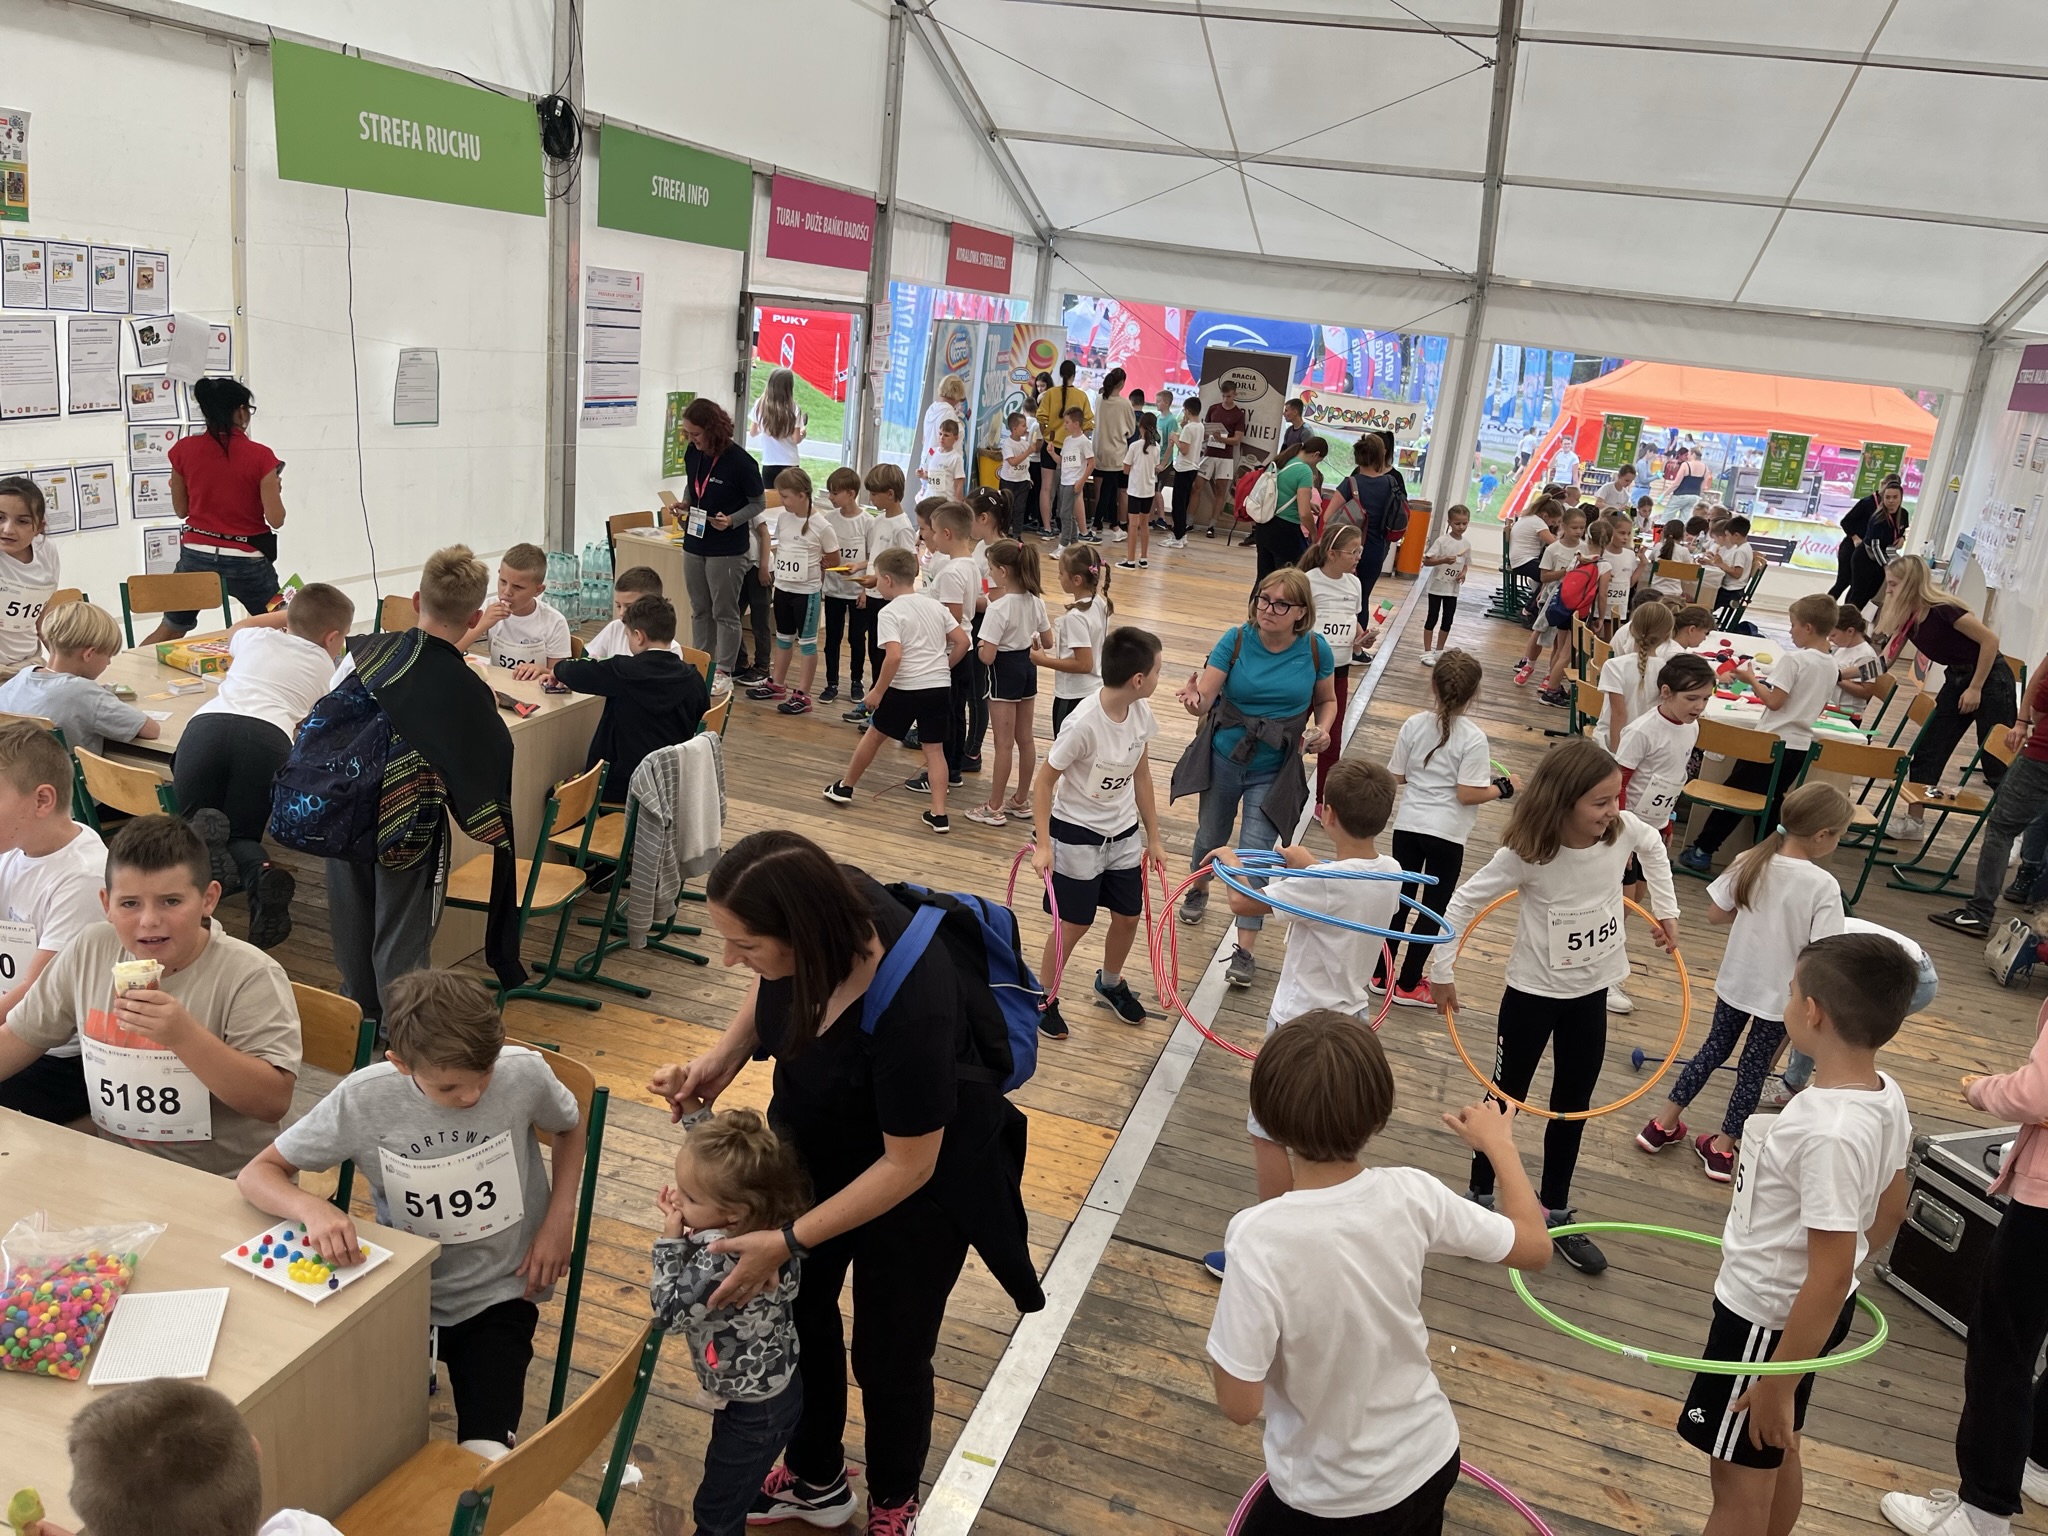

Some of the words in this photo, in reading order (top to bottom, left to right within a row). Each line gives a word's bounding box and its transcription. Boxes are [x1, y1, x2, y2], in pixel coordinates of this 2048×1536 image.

[359, 111, 423, 151] STREFA
[425, 125, 480, 162] RUCHU
[651, 175, 686, 203] STREFA
[687, 183, 709, 208] INFO
[776, 206, 801, 228] TUBAN
[805, 211, 823, 233] DUŻE
[823, 215, 844, 237] BAŃKI
[843, 221, 870, 242] RADOŚCI
[979, 252, 994, 268] STREFA
[636, 275, 640, 291] 1
[772, 314, 809, 327] PUKY
[1231, 372, 1257, 381] BRACIA
[777, 559, 800, 573] 5210
[1323, 623, 1352, 636] 5077
[1567, 916, 1618, 951] 5159
[100, 1078, 181, 1116] 5188
[405, 1180, 498, 1220] 5193
